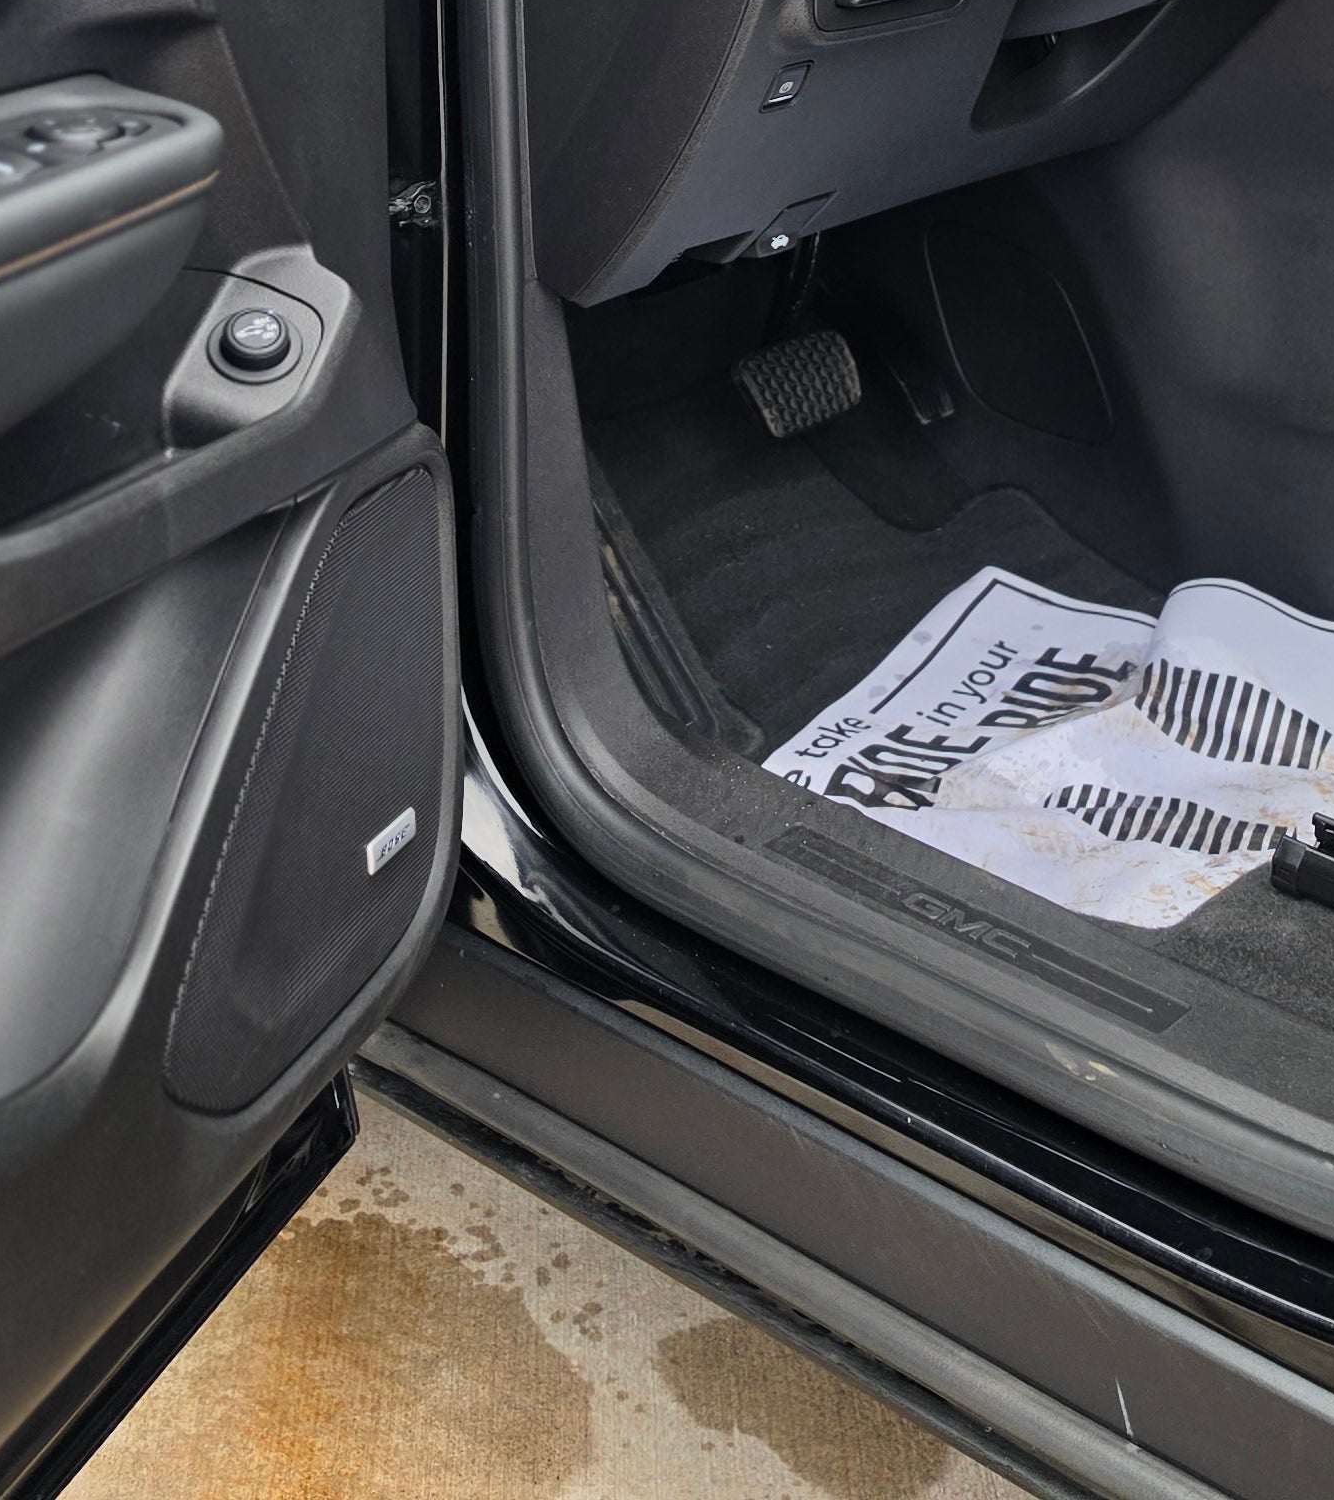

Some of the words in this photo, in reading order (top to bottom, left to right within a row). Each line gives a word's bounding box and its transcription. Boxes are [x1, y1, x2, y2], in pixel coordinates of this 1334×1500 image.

[915, 700, 967, 727] in
[952, 639, 1019, 705] your
[976, 647, 1138, 729] RIDE
[794, 716, 872, 758] take
[378, 824, 410, 861] BOSE
[900, 892, 1033, 960] GMC
